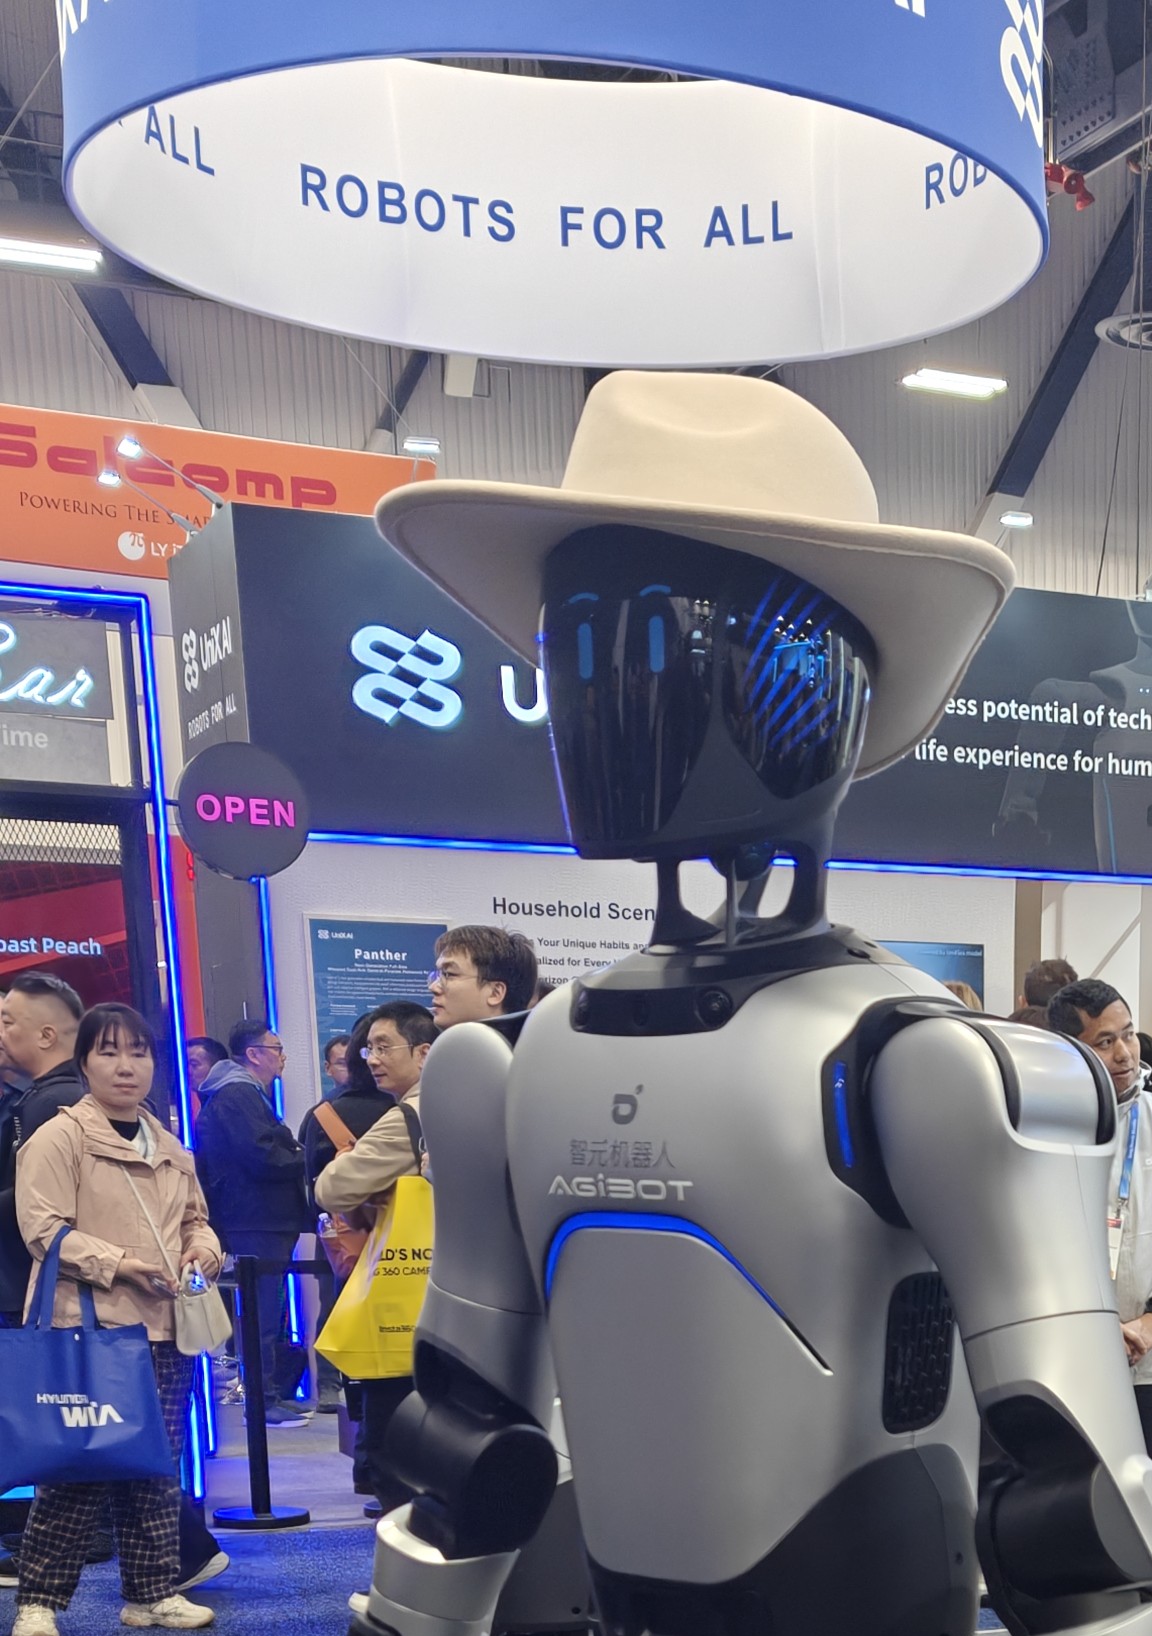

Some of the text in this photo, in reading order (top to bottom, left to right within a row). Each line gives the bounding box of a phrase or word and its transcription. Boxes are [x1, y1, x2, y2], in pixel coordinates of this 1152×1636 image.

[145, 105, 215, 176] ALL
[300, 162, 515, 242] ROBOTS
[560, 205, 666, 250] FOR
[703, 200, 793, 248] ALL
[151, 541, 168, 557] LY
[188, 693, 237, 740] ROBOTS FOR ALL
[982, 699, 1078, 725] potential
[1083, 705, 1105, 726] of
[0, 724, 49, 749] ime
[914, 739, 948, 763] life
[953, 745, 1068, 770] experience
[1073, 750, 1103, 773] for
[196, 794, 296, 828] OPEN
[493, 896, 656, 921] Household Scen
[42, 937, 102, 955] Peach
[354, 948, 407, 961] Panther
[537, 938, 560, 947] Your
[562, 939, 597, 950] Unique
[600, 940, 629, 950] Habits
[567, 957, 580, 966] for
[583, 958, 611, 968] Every
[570, 1138, 676, 1169] 智元机器人
